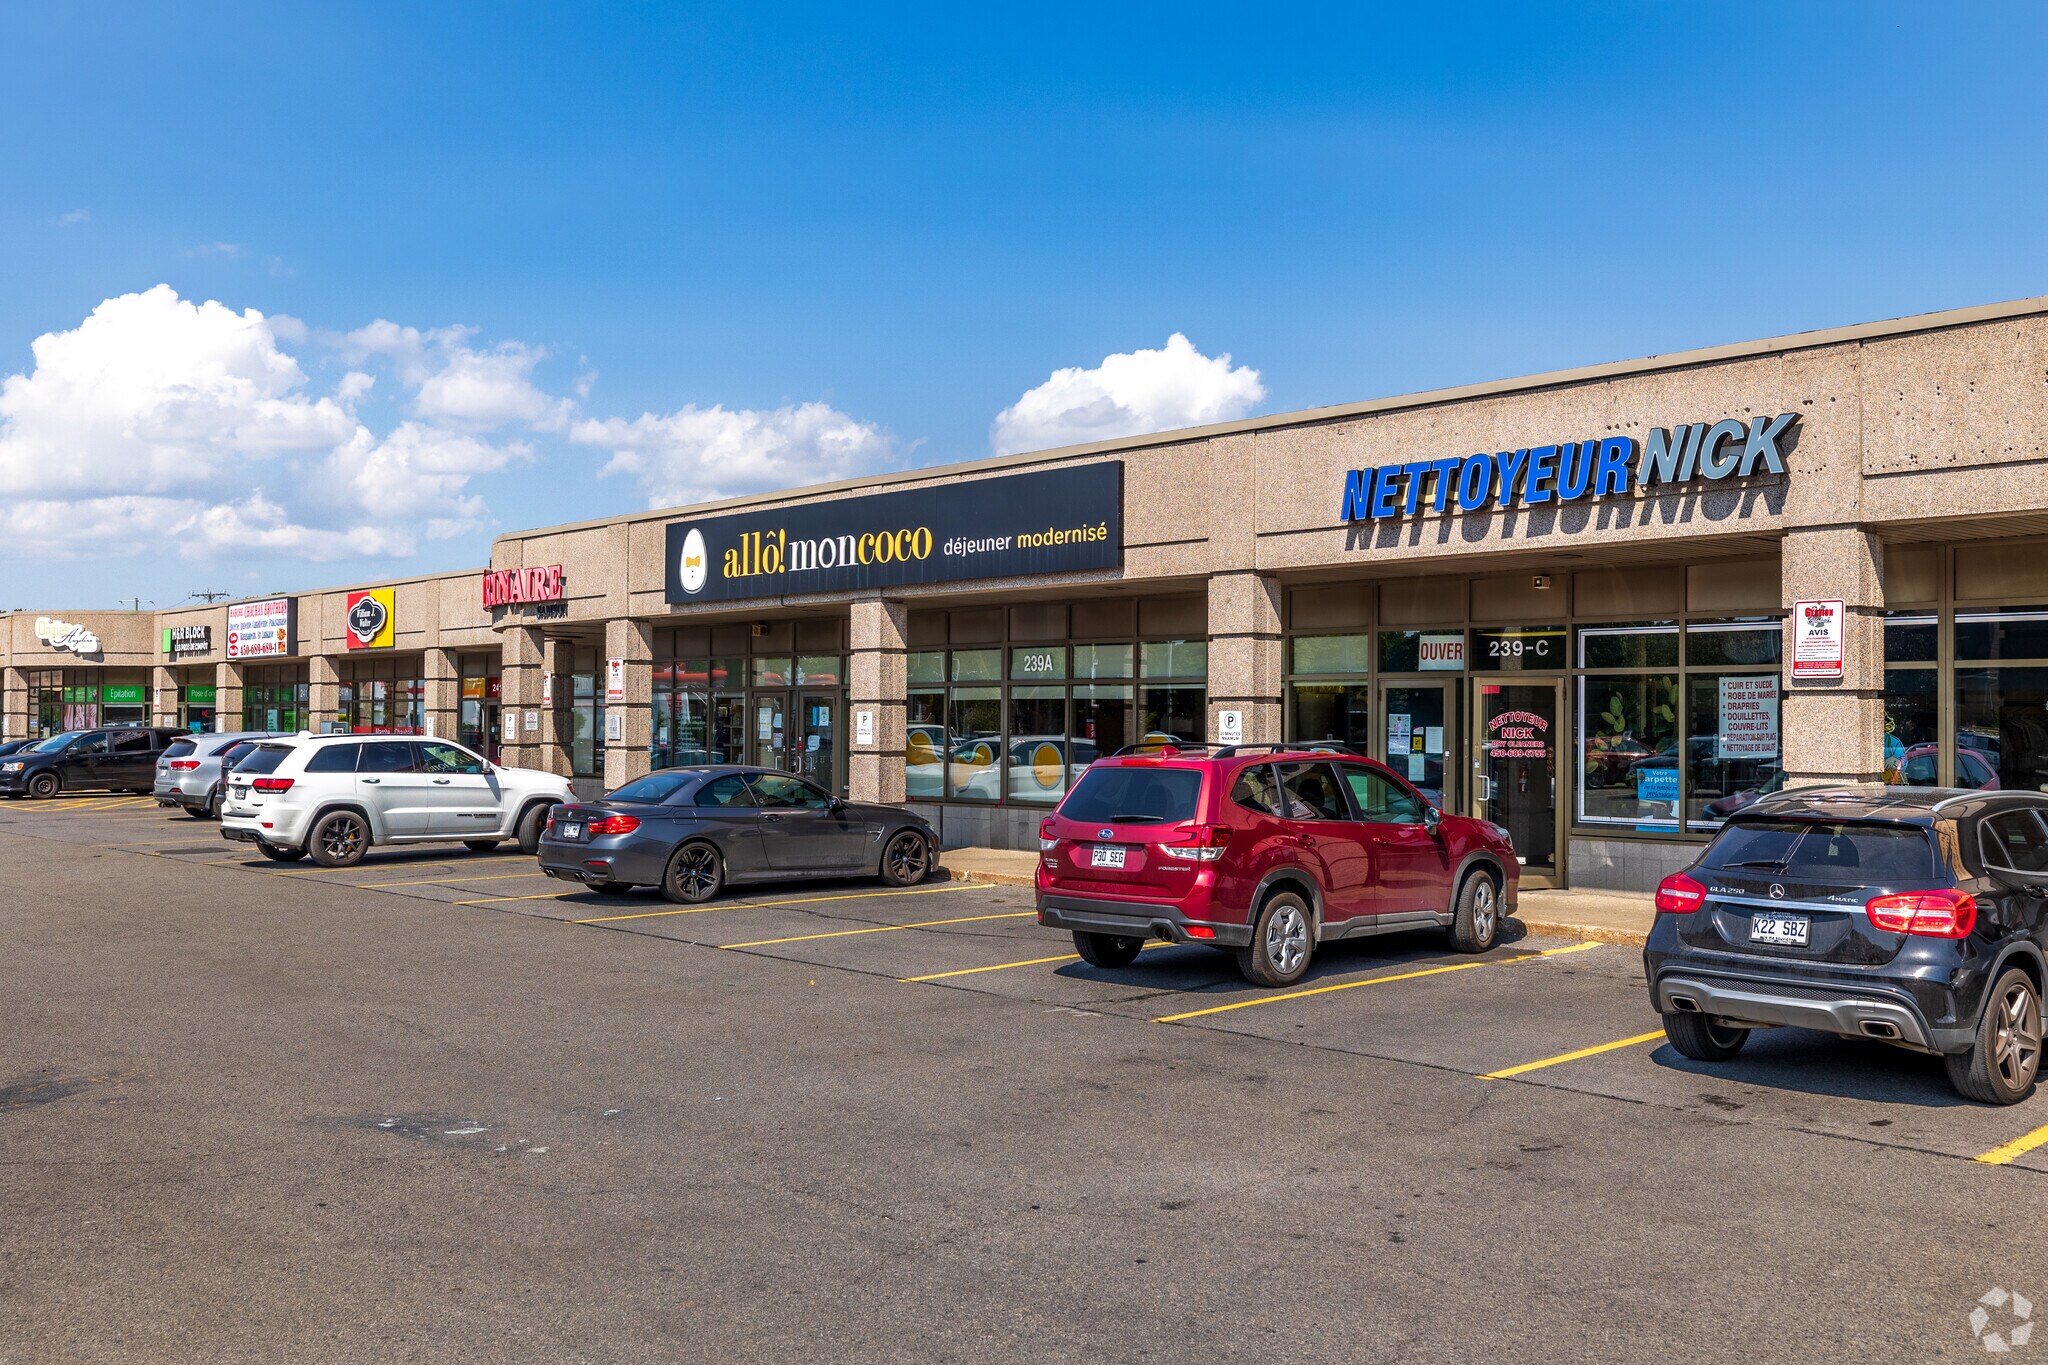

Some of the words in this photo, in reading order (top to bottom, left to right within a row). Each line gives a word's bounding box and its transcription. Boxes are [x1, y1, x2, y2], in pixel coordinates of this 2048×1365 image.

[1340, 436, 1638, 522] NETTOYEUR
[1638, 412, 1801, 486] NICK
[943, 534, 1012, 557] déjeuner
[1017, 521, 1107, 549] modernisé
[38, 621, 68, 638] Ongles
[185, 626, 205, 639] BLOCK
[1421, 643, 1464, 660] OUVER
[1489, 640, 1549, 657] 239-C
[1024, 655, 1053, 673] 239A
[1746, 681, 1753, 689] ET
[1755, 680, 1773, 688] SUEDE
[110, 688, 136, 698] Épilation
[1727, 692, 1746, 700] ROBE
[1748, 691, 1756, 699] DE
[1758, 689, 1777, 699] MARIÉE
[1727, 702, 1760, 710] DRAPRIES
[1488, 711, 1548, 732] NETTOYEUR
[1728, 723, 1769, 731] COUVRE-LITS
[1502, 727, 1534, 739] NICK
[1507, 740, 1545, 748] CLEANERS
[1727, 744, 1754, 752] NETTOYAGE
[1755, 743, 1761, 751] DE
[1642, 776, 1678, 784] arpette
[1109, 851, 1123, 863] SEG
[1827, 895, 1859, 903] 4MATIC
[1753, 918, 1776, 934] K22
[1783, 921, 1806, 937] SBZ
